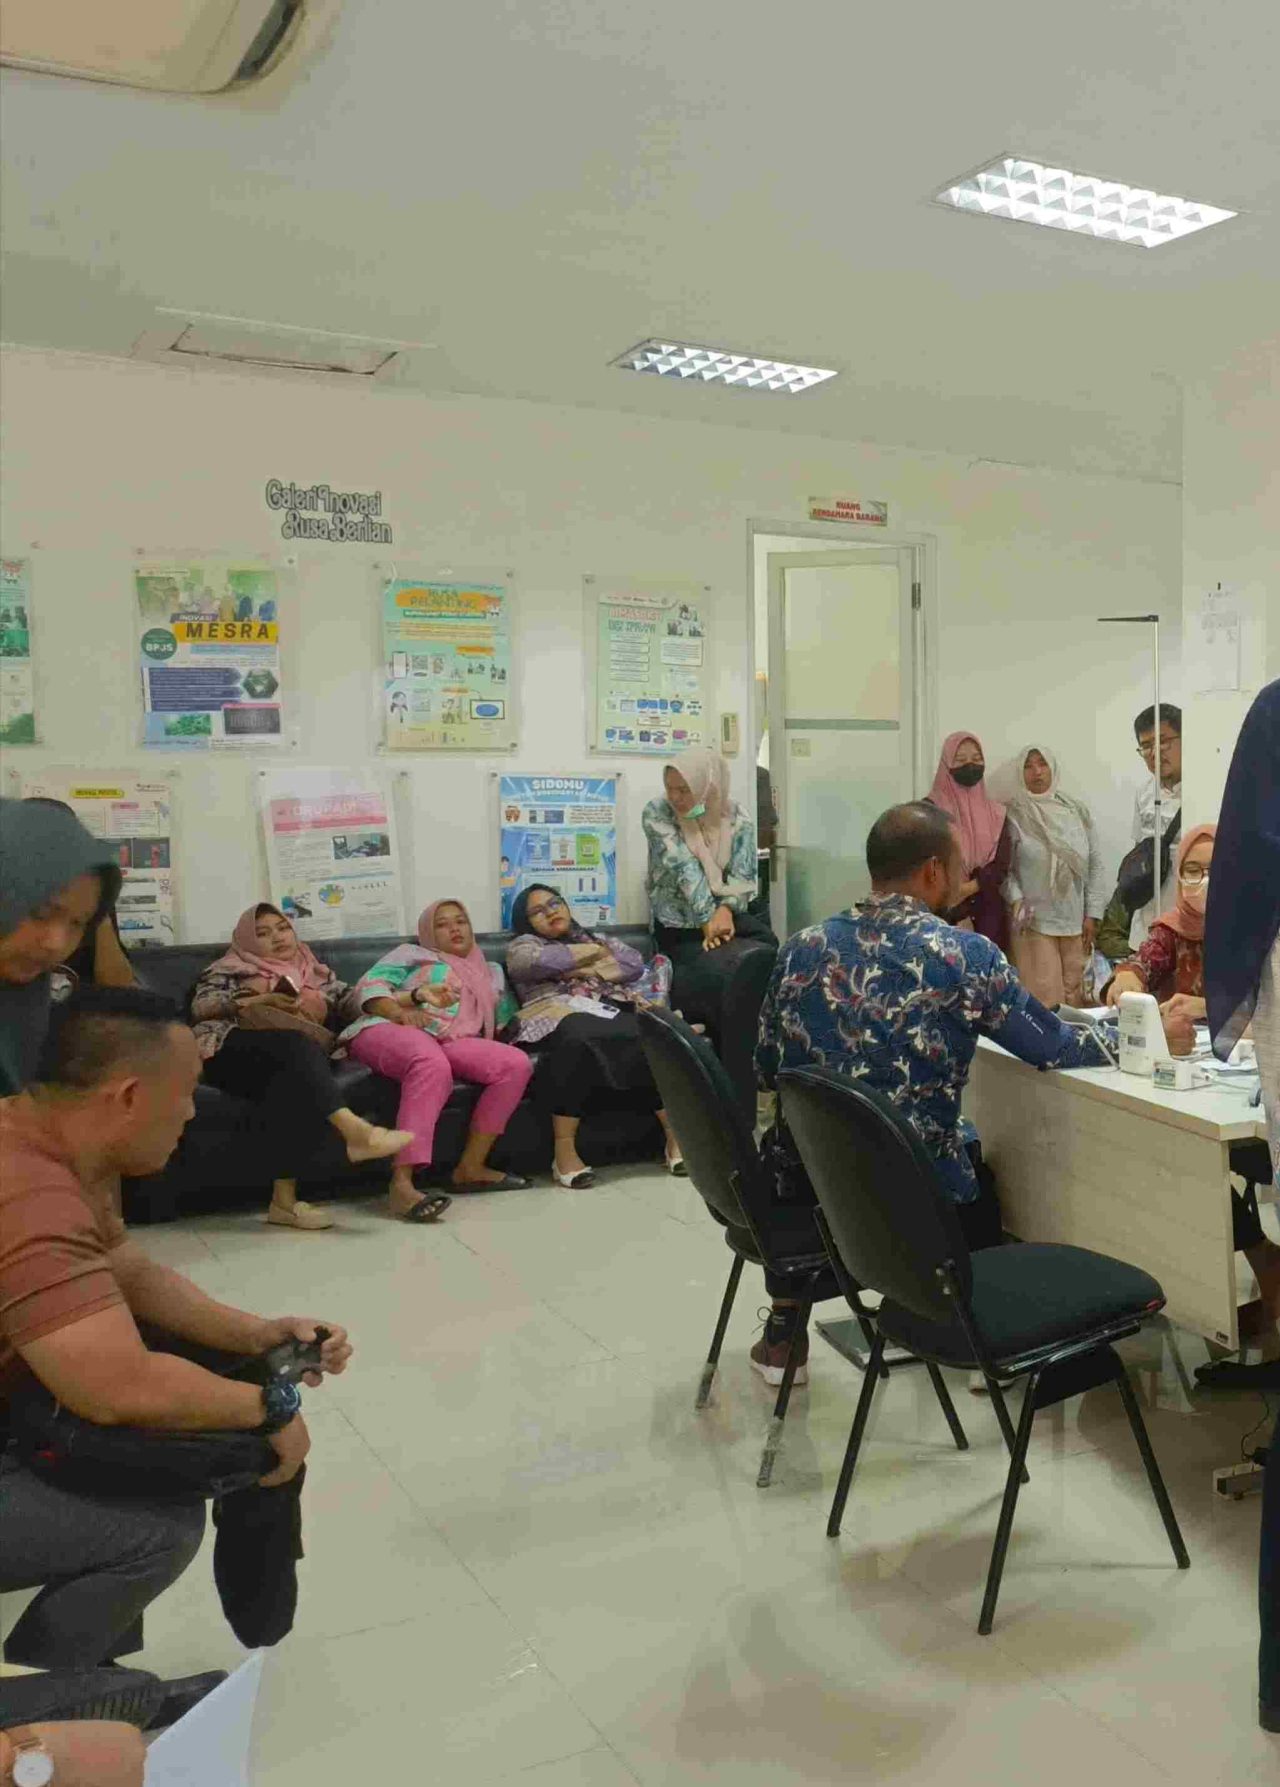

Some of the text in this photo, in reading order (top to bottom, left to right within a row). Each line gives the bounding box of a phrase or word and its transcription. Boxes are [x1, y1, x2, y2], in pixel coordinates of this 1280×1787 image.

[266, 479, 382, 516] Galeri Inovasi
[281, 509, 392, 544] Rusa Berlian
[186, 622, 269, 639] MESRA
[145, 643, 174, 652] BPJS
[531, 779, 585, 790] SIDOMU
